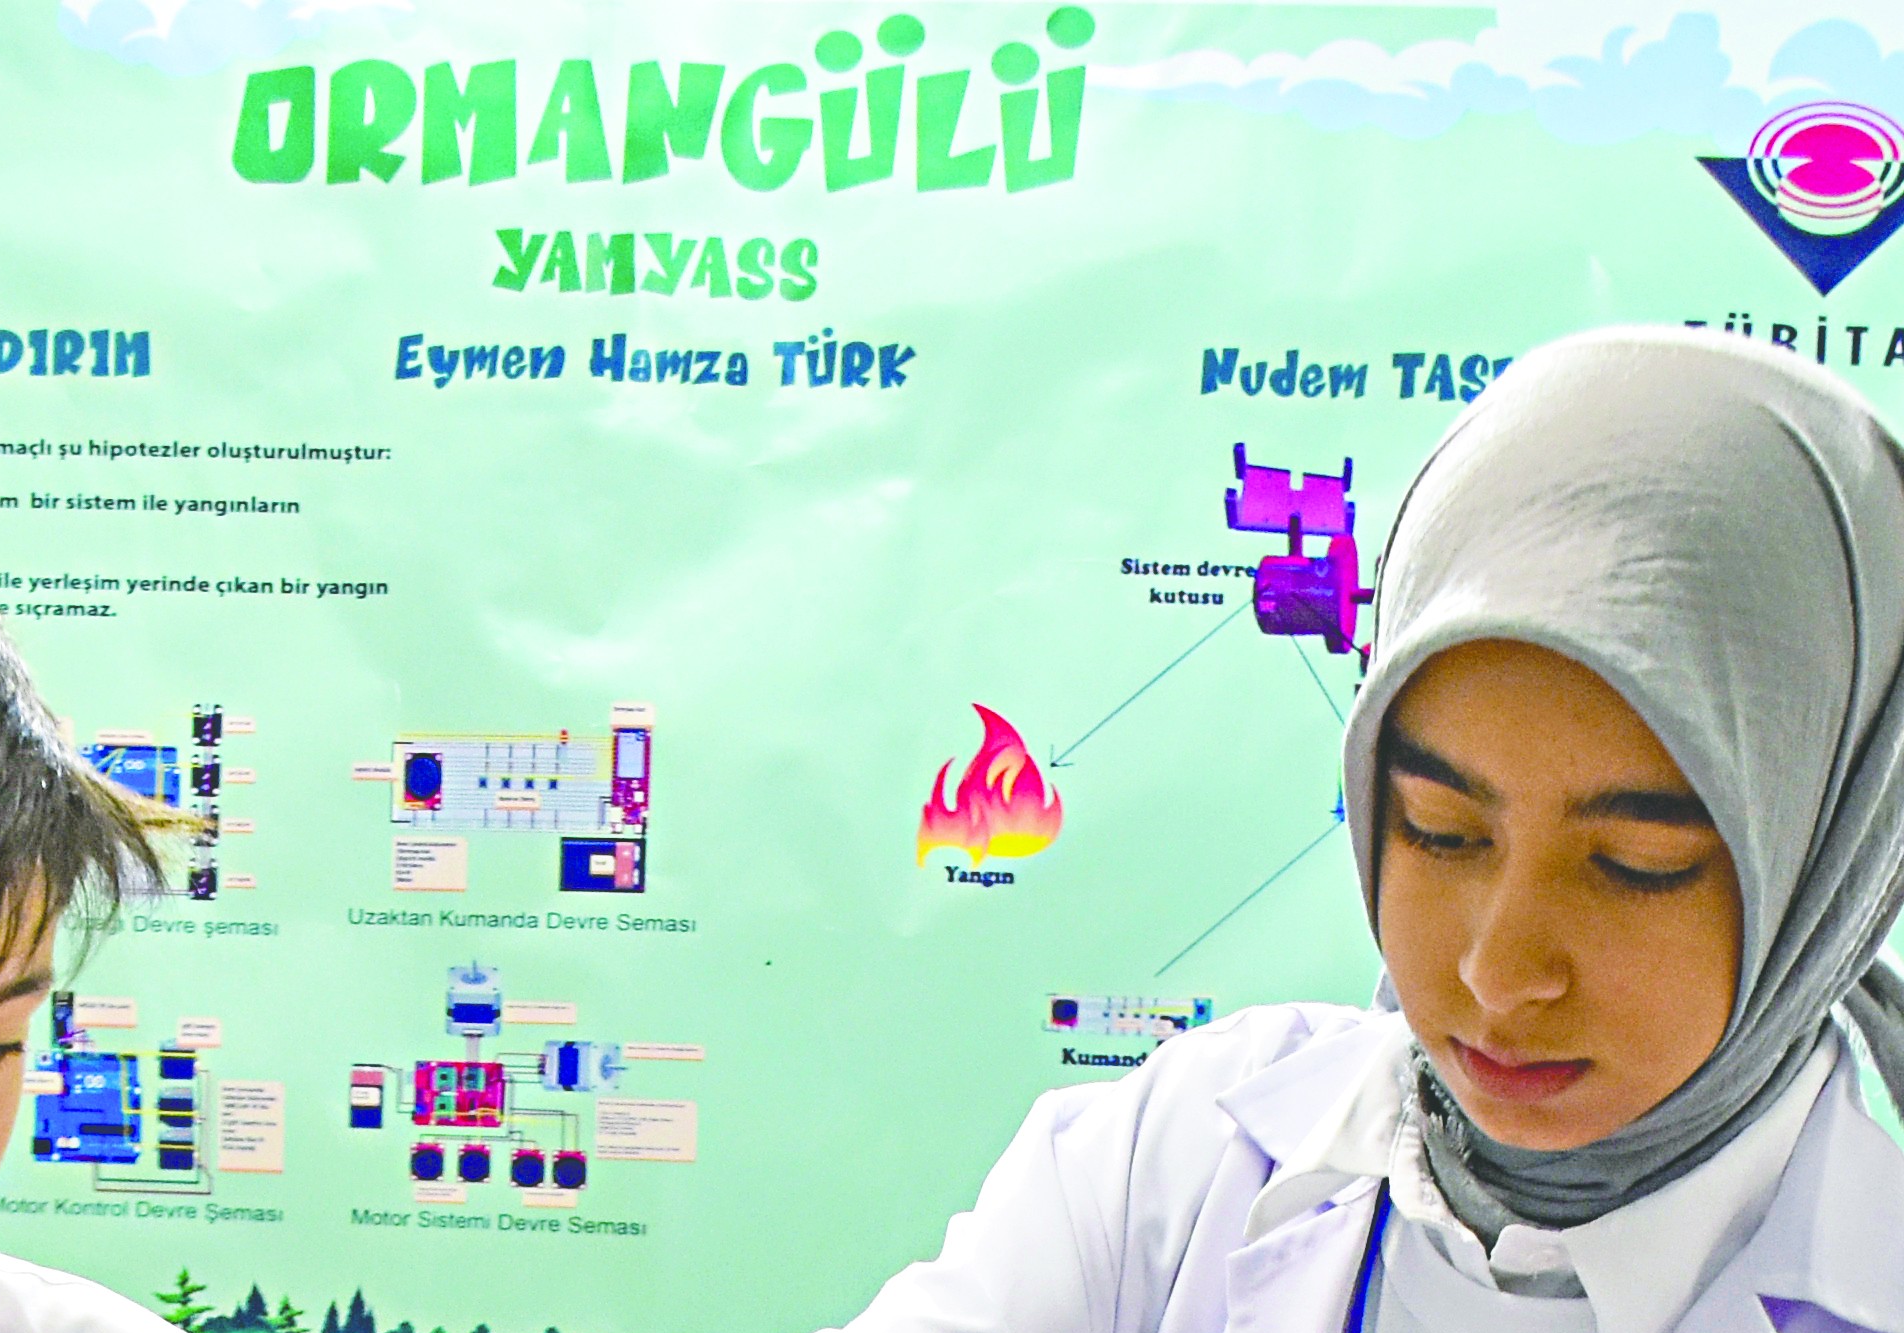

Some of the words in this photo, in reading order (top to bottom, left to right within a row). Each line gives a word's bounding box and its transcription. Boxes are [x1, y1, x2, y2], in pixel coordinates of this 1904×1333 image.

[230, 5, 1097, 194] ORMANGÜLÜ
[492, 228, 819, 302] YAMYASS
[394, 332, 567, 389] Eymen
[590, 332, 748, 386] Hamza
[773, 327, 917, 389] TÜRK
[1200, 348, 1368, 399] Nudem
[60, 442, 81, 461] şu
[89, 439, 200, 462] hipotezler
[208, 442, 391, 465] oluşturulmuştur:
[31, 492, 60, 509] bir
[66, 494, 136, 511] sistem
[143, 494, 168, 512] ile
[174, 496, 300, 516] yangınların
[1120, 558, 1190, 578] Sistem
[1197, 558, 1257, 578] devre
[29, 573, 119, 595] yerleşim
[126, 575, 209, 596] yerinde
[216, 576, 274, 598] çıkan
[281, 577, 311, 595] bir
[316, 579, 388, 600] yangın
[1149, 588, 1224, 606] kutusu
[15, 602, 116, 621] sıçramaz.
[945, 866, 1015, 887] Yangın
[132, 915, 195, 934] Devre
[204, 918, 278, 939] şeması
[348, 908, 433, 926] Uzaktan
[440, 910, 539, 929] Kumanda
[546, 912, 608, 930] Devre
[616, 914, 696, 933] Seması
[1062, 1048, 1149, 1068] Kumand
[54, 1198, 127, 1217] Kontrol
[135, 1201, 197, 1219] Devre
[205, 1203, 283, 1224] Şeması
[351, 1208, 410, 1226] Motor
[417, 1210, 491, 1229] Sistemi
[497, 1213, 561, 1232] Devre
